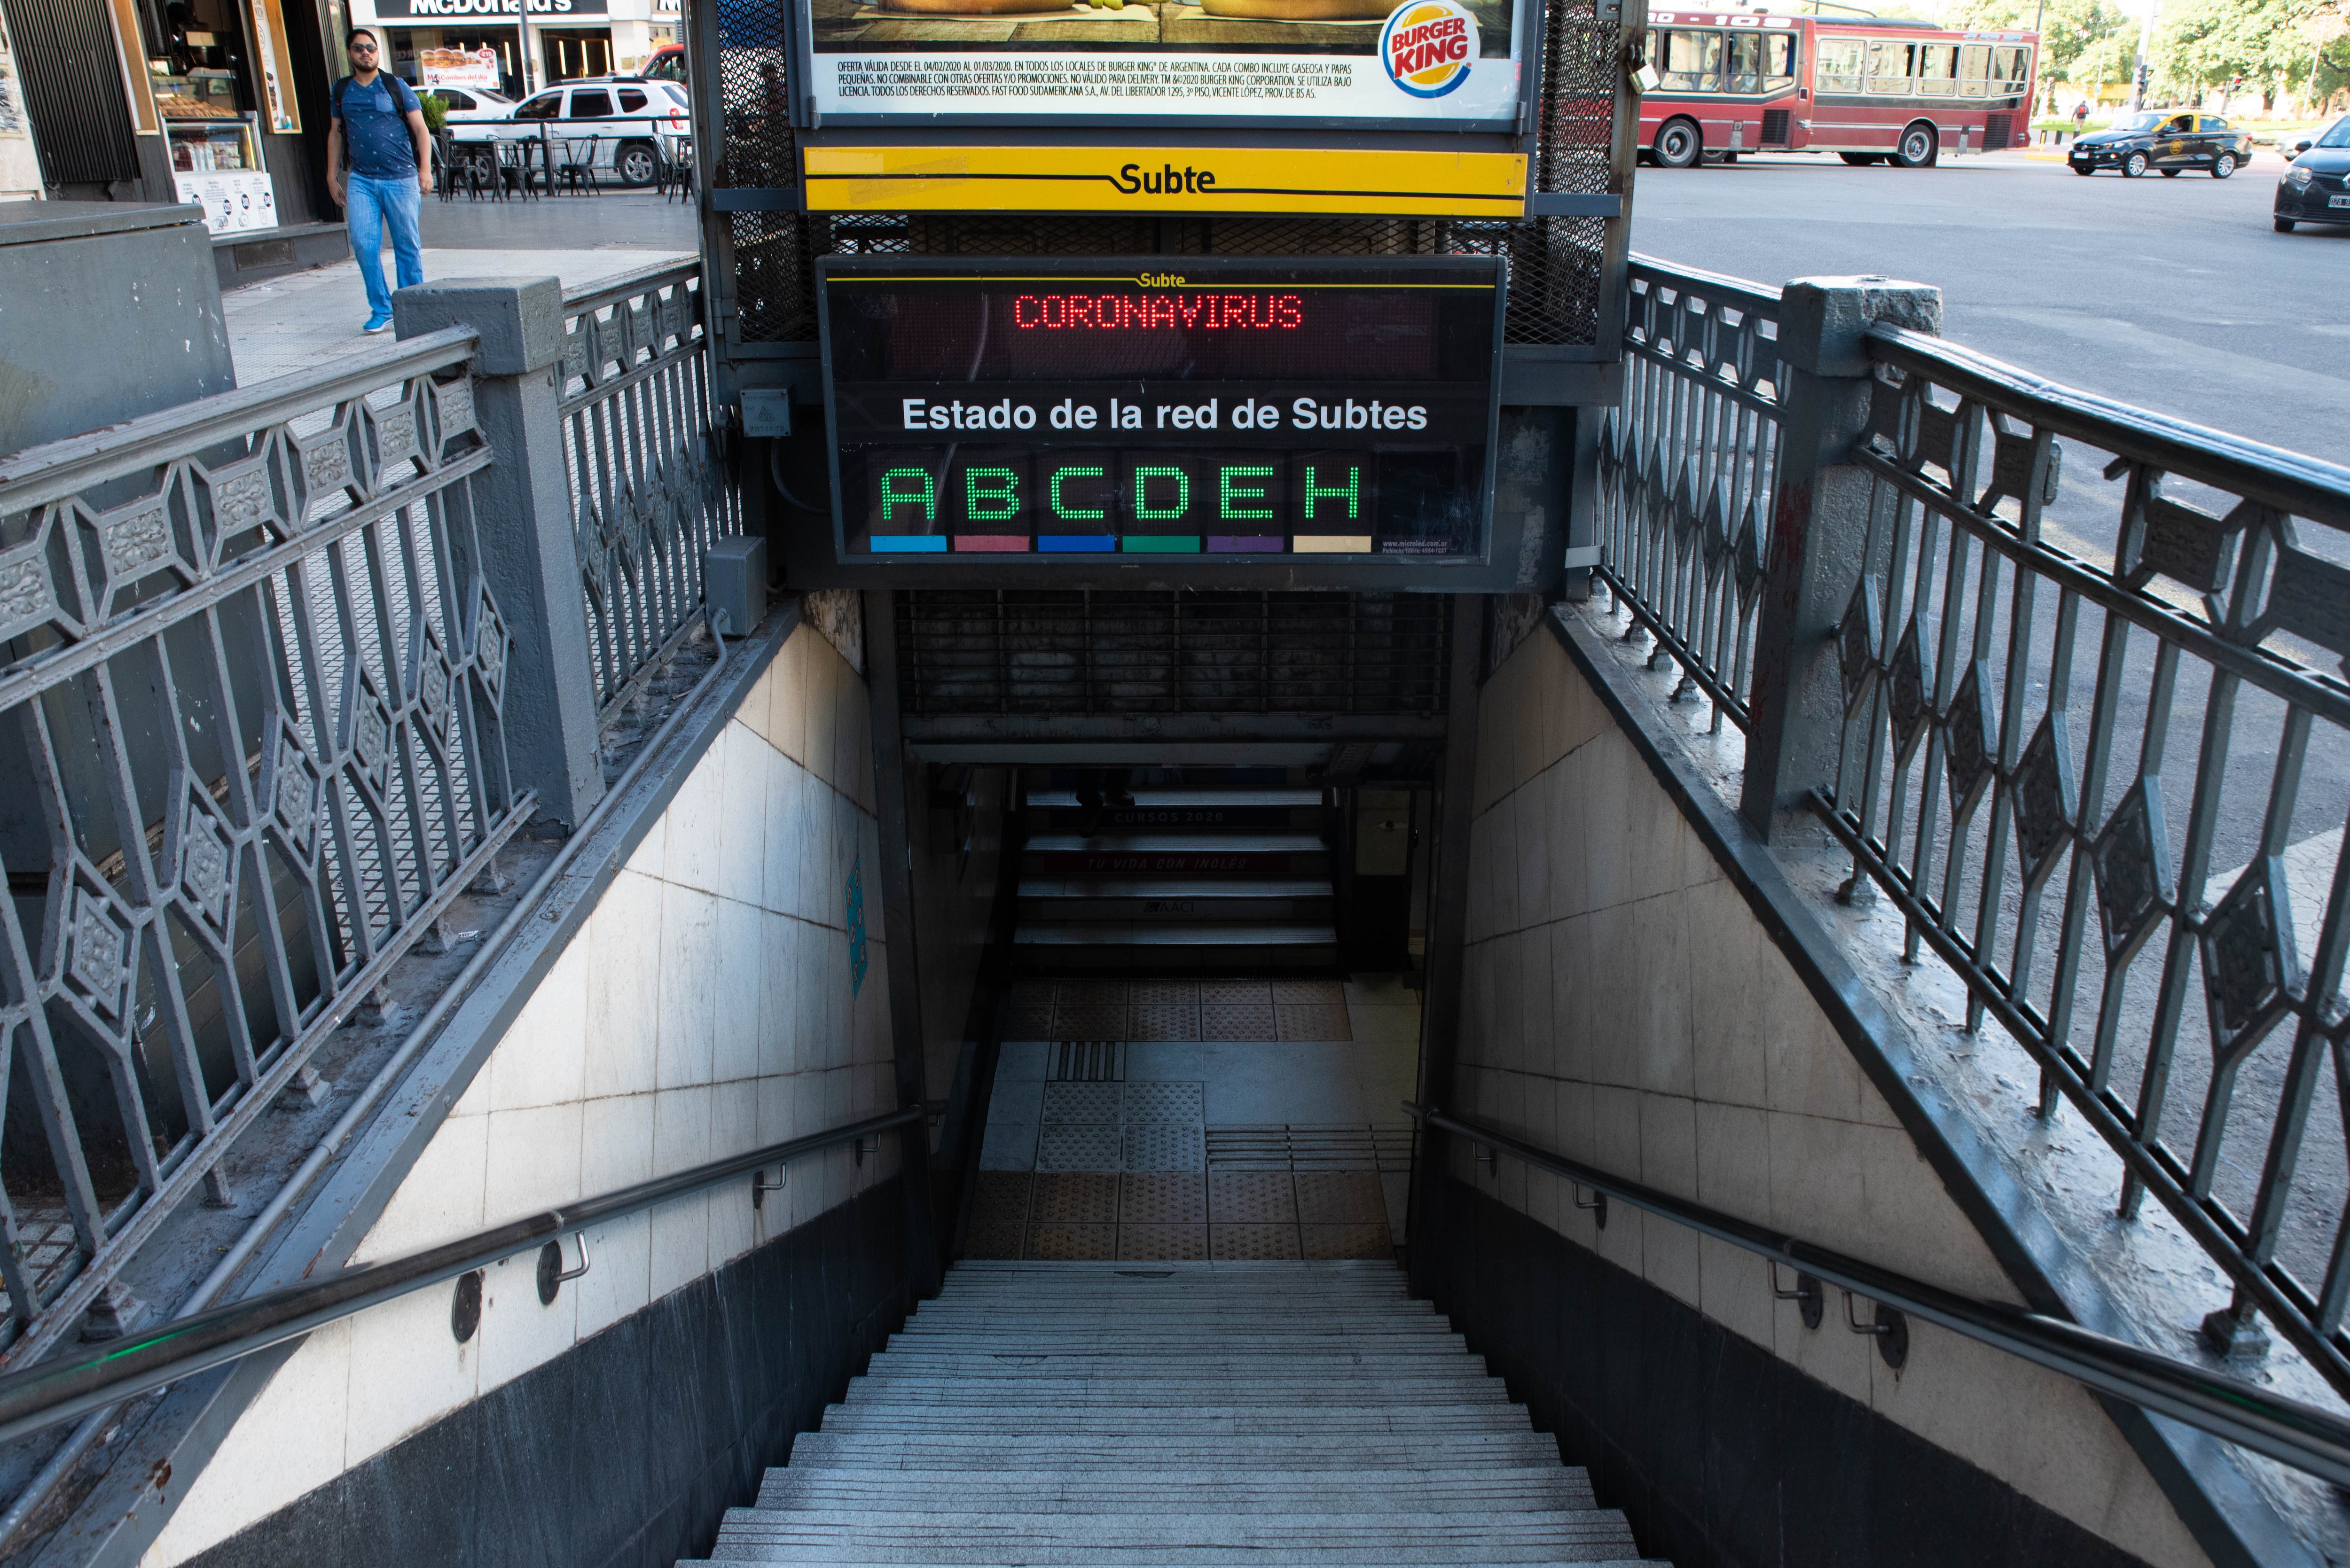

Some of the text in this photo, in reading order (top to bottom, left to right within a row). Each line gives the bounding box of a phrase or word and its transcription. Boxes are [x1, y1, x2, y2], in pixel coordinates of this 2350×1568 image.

[410, 0, 572, 14] McDonalds
[1715, 15, 1792, 28] 109
[1392, 18, 1465, 54] BURGER
[1394, 35, 1468, 79] KING
[838, 62, 863, 71] OFERTA
[864, 59, 889, 71] VÁLIDA
[890, 62, 912, 71] DESDE
[915, 62, 922, 71] EL
[924, 62, 961, 71] 04/02/2020
[963, 62, 972, 71] AL
[974, 62, 1013, 71] 01/03/2020.
[1015, 62, 1023, 71] EN
[1025, 62, 1049, 71] TODOS
[1051, 62, 1064, 71] LOS
[1065, 62, 1095, 71] LOCALES
[1097, 62, 1106, 72] DE
[1108, 62, 1135, 72] BURGER
[1158, 62, 1168, 72] DE
[1170, 62, 1210, 72] ARGENTINA.
[1212, 62, 1231, 72] CADA
[1233, 63, 1259, 73] COMBO
[1261, 63, 1290, 73] INCLUYE
[1291, 63, 1324, 73] GASEOSA
[1324, 63, 1329, 74] Y
[1331, 64, 1352, 74] PAPAS
[838, 72, 876, 85] PEQUEÑAS.
[877, 74, 887, 84] NO
[889, 74, 932, 84] COMBINABLE
[933, 74, 948, 84] CON
[950, 74, 972, 84] OTRAS
[973, 74, 1003, 84] OFERTAS
[1003, 74, 1016, 84] Y/O
[1018, 74, 1069, 84] PROMOCIONES.
[1071, 74, 1081, 84] NO
[1082, 72, 1107, 84] VÁLIDO
[1109, 74, 1126, 84] PARA
[1128, 74, 1159, 84] DELIVERY.
[1160, 75, 1171, 85] TM
[1200, 75, 1227, 85] BURGER
[1228, 75, 1245, 85] KING
[1246, 76, 1296, 86] CORPORATION.
[1297, 76, 1305, 86] SE
[1307, 76, 1332, 86] UTILIZA
[1334, 76, 1352, 86] BAJO
[839, 86, 870, 96] LICENCIA.
[871, 86, 895, 96] TODOS
[896, 86, 909, 96] LOS
[910, 86, 945, 96] DERECHOS
[947, 86, 991, 96] RESERVADOS.
[992, 86, 1008, 96] FAST
[1009, 86, 1028, 96] FOOD
[1029, 86, 1083, 96] SUDAMERICANA
[1085, 86, 1098, 98] S.A.,
[1100, 86, 1110, 96] AV.
[1111, 86, 1124, 96] DEL
[1125, 86, 1166, 96] LIBERTADOR
[1167, 87, 1184, 98] 1295,
[1195, 87, 1211, 98] PISO,
[1212, 87, 1239, 97] VICENTE
[1241, 86, 1264, 99] LÓPEZ,
[1265, 88, 1285, 98] PROV.
[1286, 88, 1295, 98] DE
[1296, 88, 1304, 98] BS
[1305, 88, 1316, 98] AS.
[1120, 163, 1215, 194] Subte
[1140, 273, 1185, 288] Subte
[1015, 294, 1302, 329] CORONAVIRUS
[903, 398, 1427, 429] Estado de la red de Subtes
[881, 467, 1358, 520] A B C D E H
[1114, 811, 1223, 823] CURSOS 2020
[1088, 858, 1106, 869] TU
[1113, 858, 1148, 869] VIDA
[1156, 858, 1186, 869] CON
[1159, 902, 1194, 913] AACI
